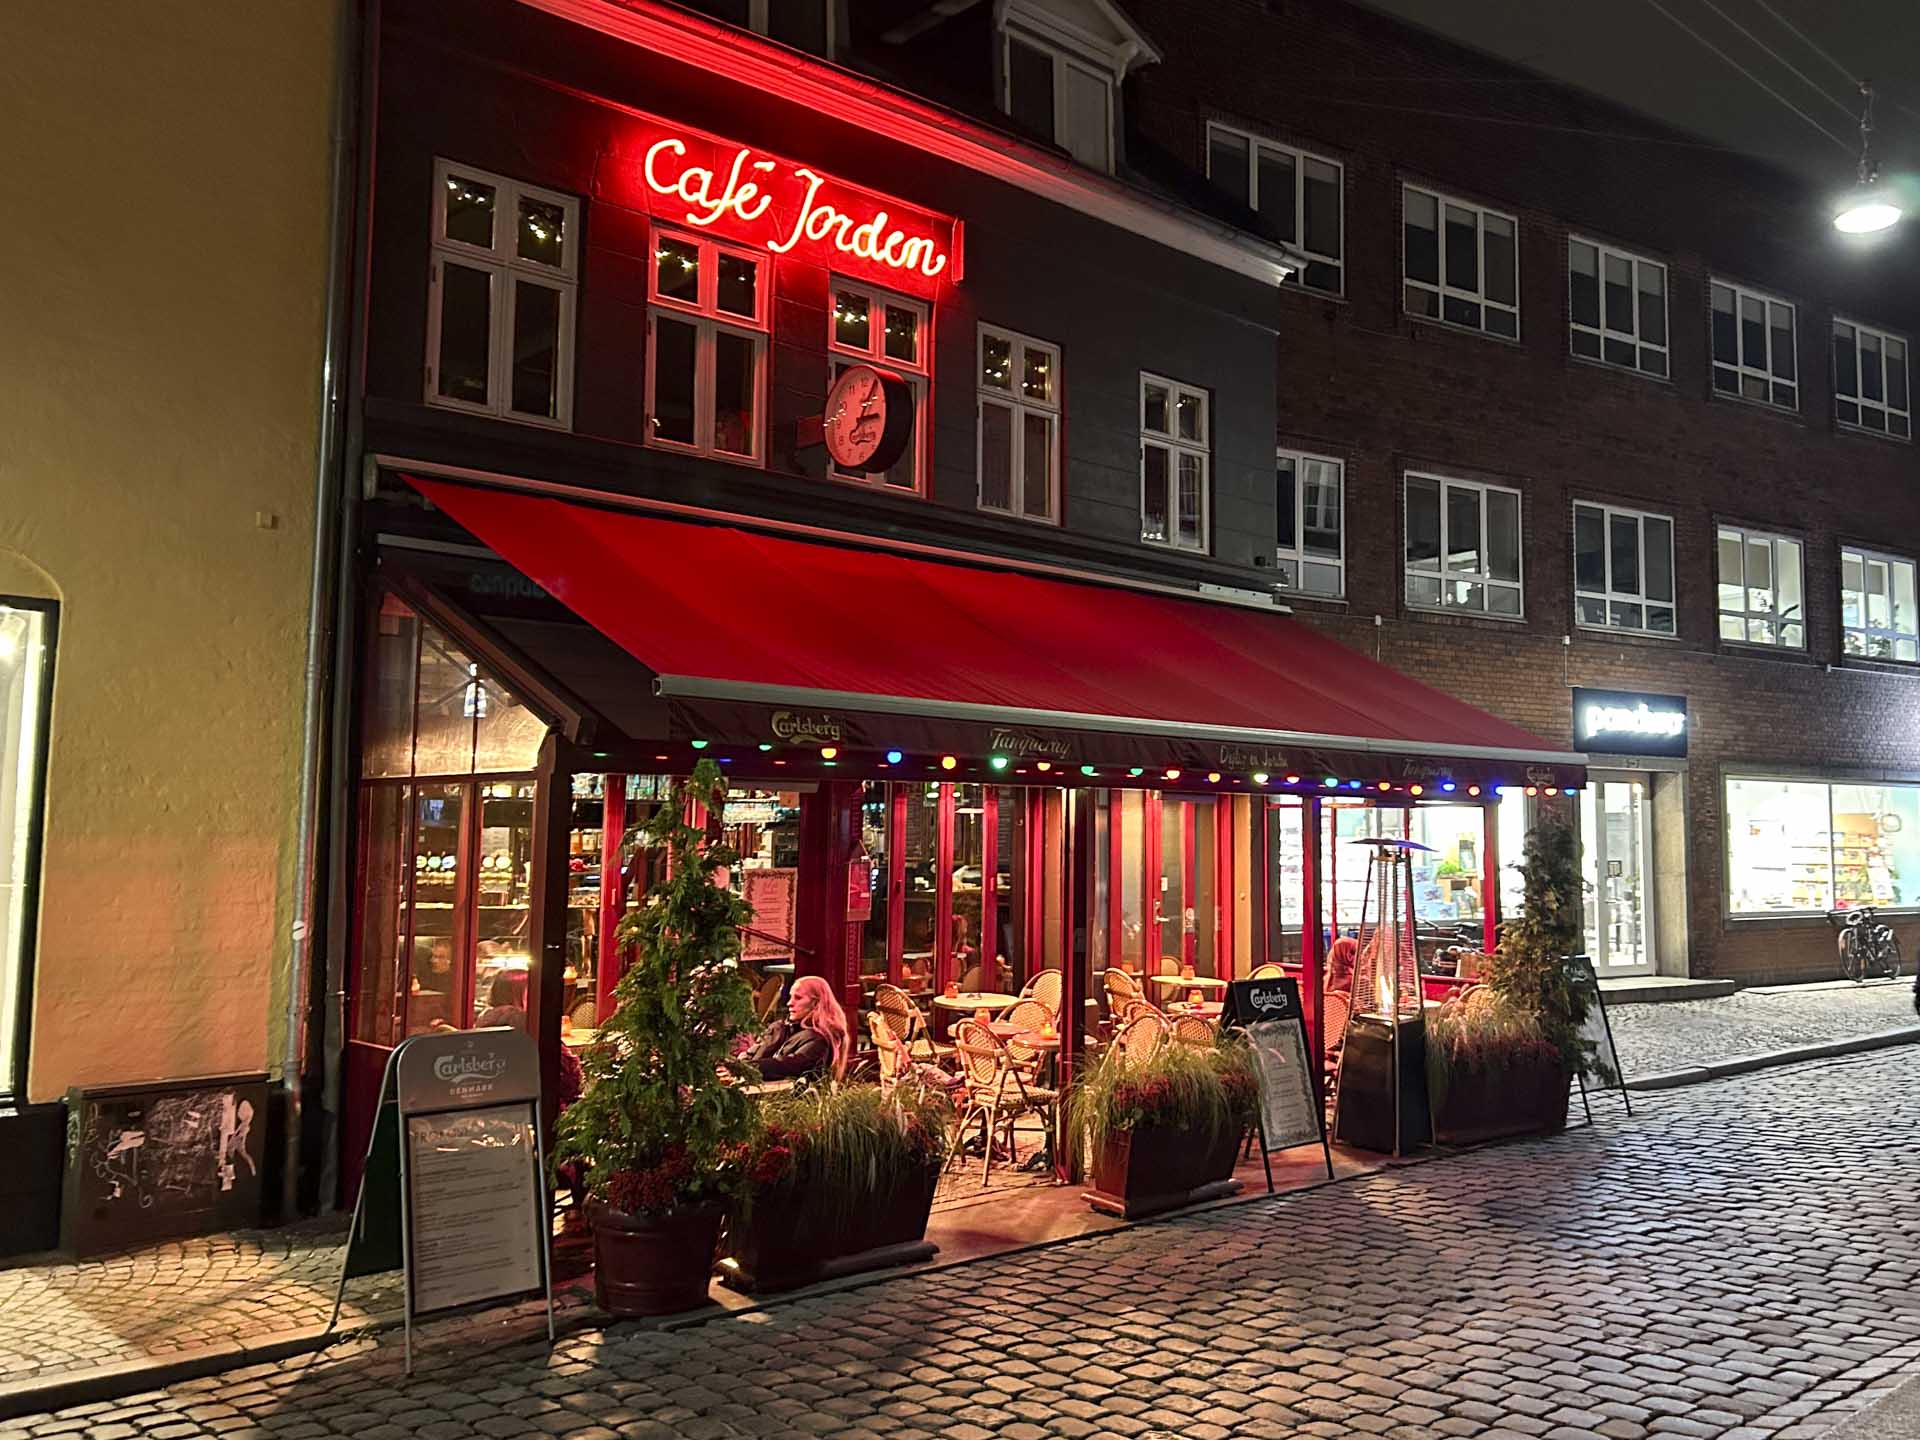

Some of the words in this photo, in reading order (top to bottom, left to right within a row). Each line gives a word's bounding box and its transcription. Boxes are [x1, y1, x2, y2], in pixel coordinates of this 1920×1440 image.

[645, 138, 776, 225] Café
[768, 168, 945, 276] Jorden
[770, 711, 841, 744] Carlsberg
[1249, 987, 1288, 1012] Carlsberg
[434, 1052, 507, 1084] Carlsberg
